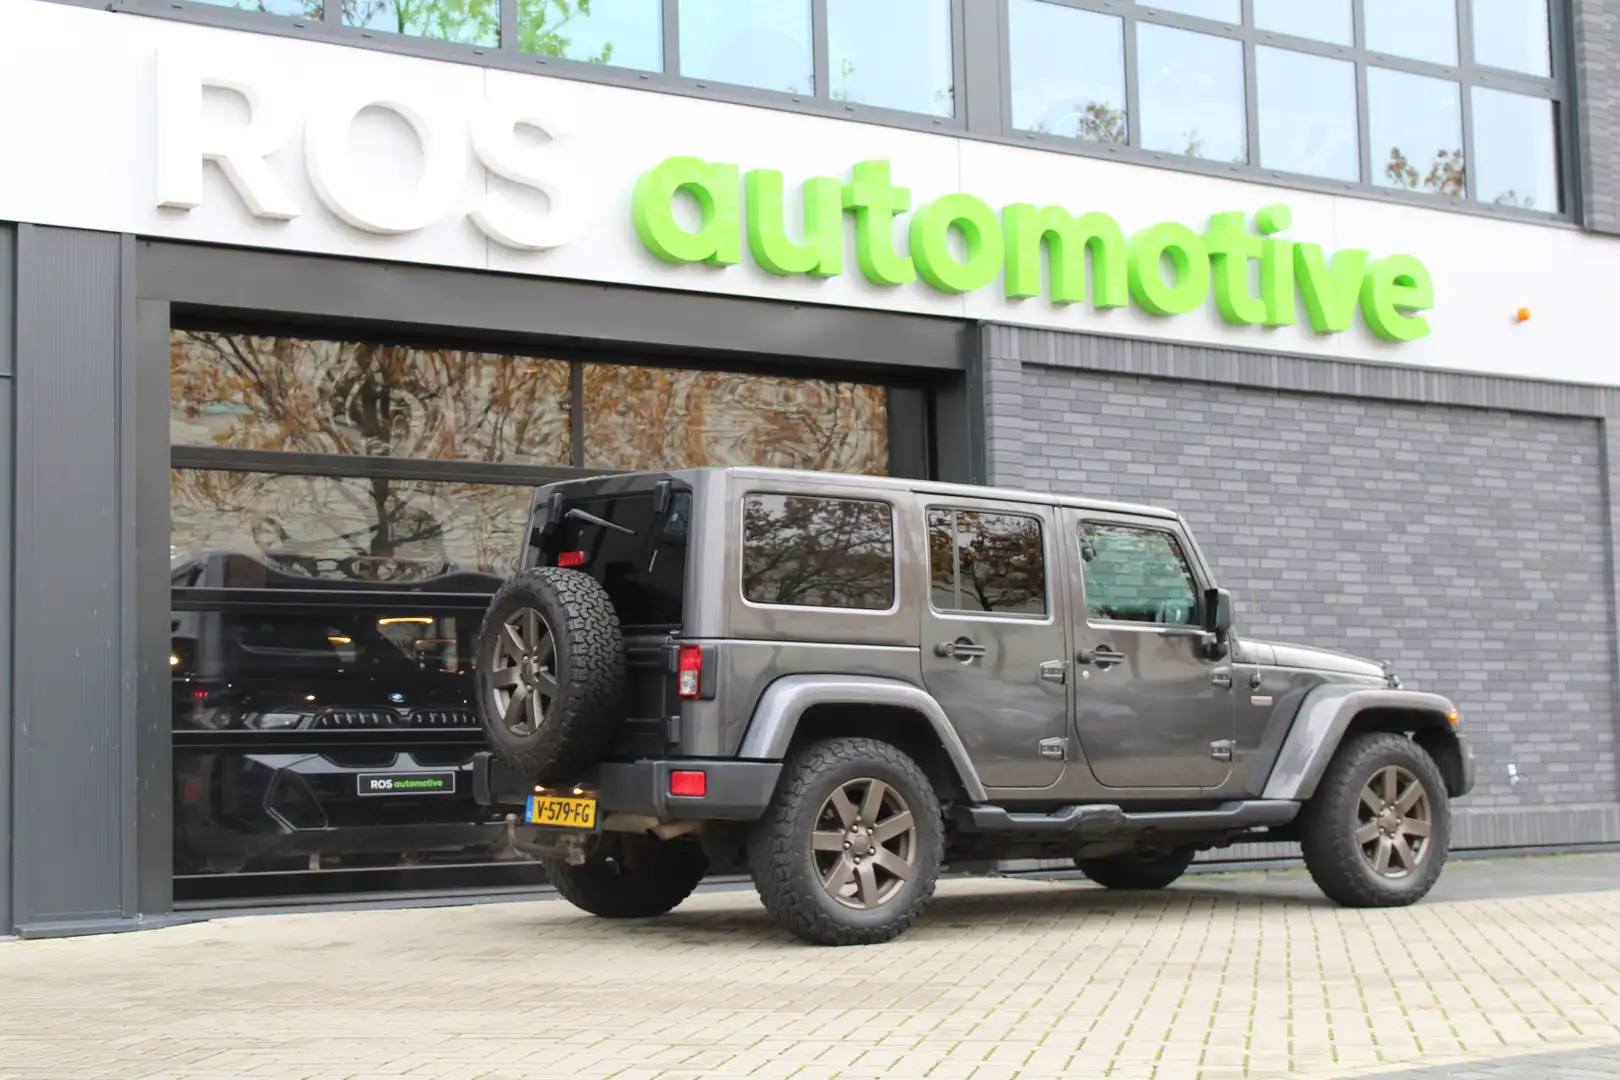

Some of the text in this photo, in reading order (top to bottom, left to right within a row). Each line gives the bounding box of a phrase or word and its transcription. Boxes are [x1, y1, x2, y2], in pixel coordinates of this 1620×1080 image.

[154, 46, 1435, 342] ROS automotive
[370, 778, 444, 790] ROS automotive
[537, 799, 590, 823] V-579-FG
